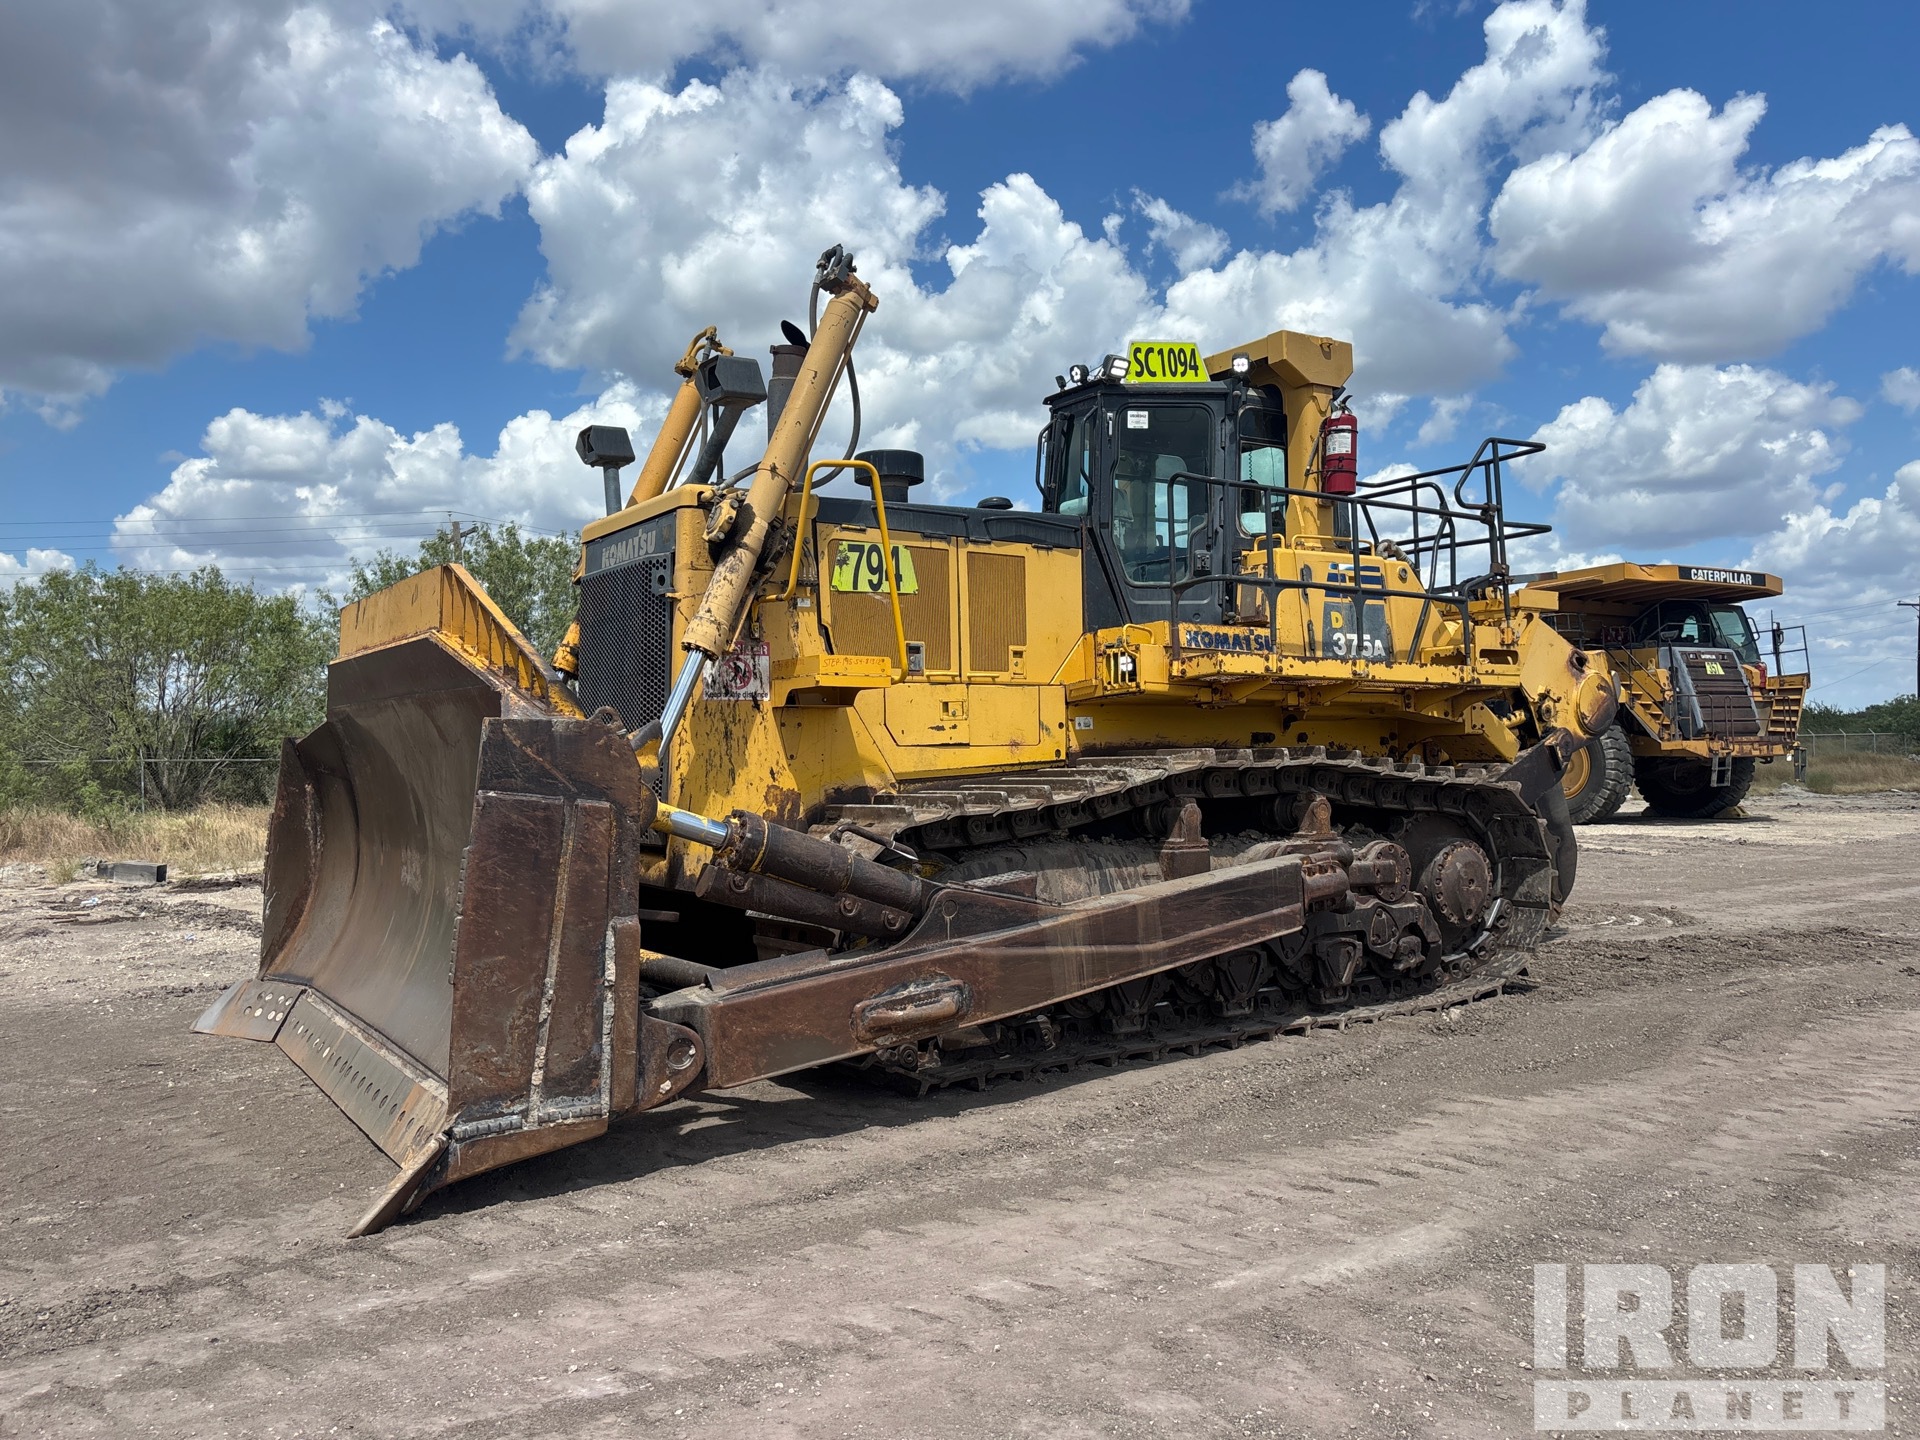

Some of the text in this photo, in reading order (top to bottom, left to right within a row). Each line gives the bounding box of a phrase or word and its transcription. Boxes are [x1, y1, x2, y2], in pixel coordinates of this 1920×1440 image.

[1133, 346, 1199, 378] SC1094
[601, 528, 656, 569] KOMATSU
[847, 543, 903, 592] 794
[1690, 568, 1752, 585] CATERPILLAR
[1330, 611, 1344, 629] D
[1186, 628, 1275, 652] KOMATSU
[1332, 632, 1386, 657] 375A
